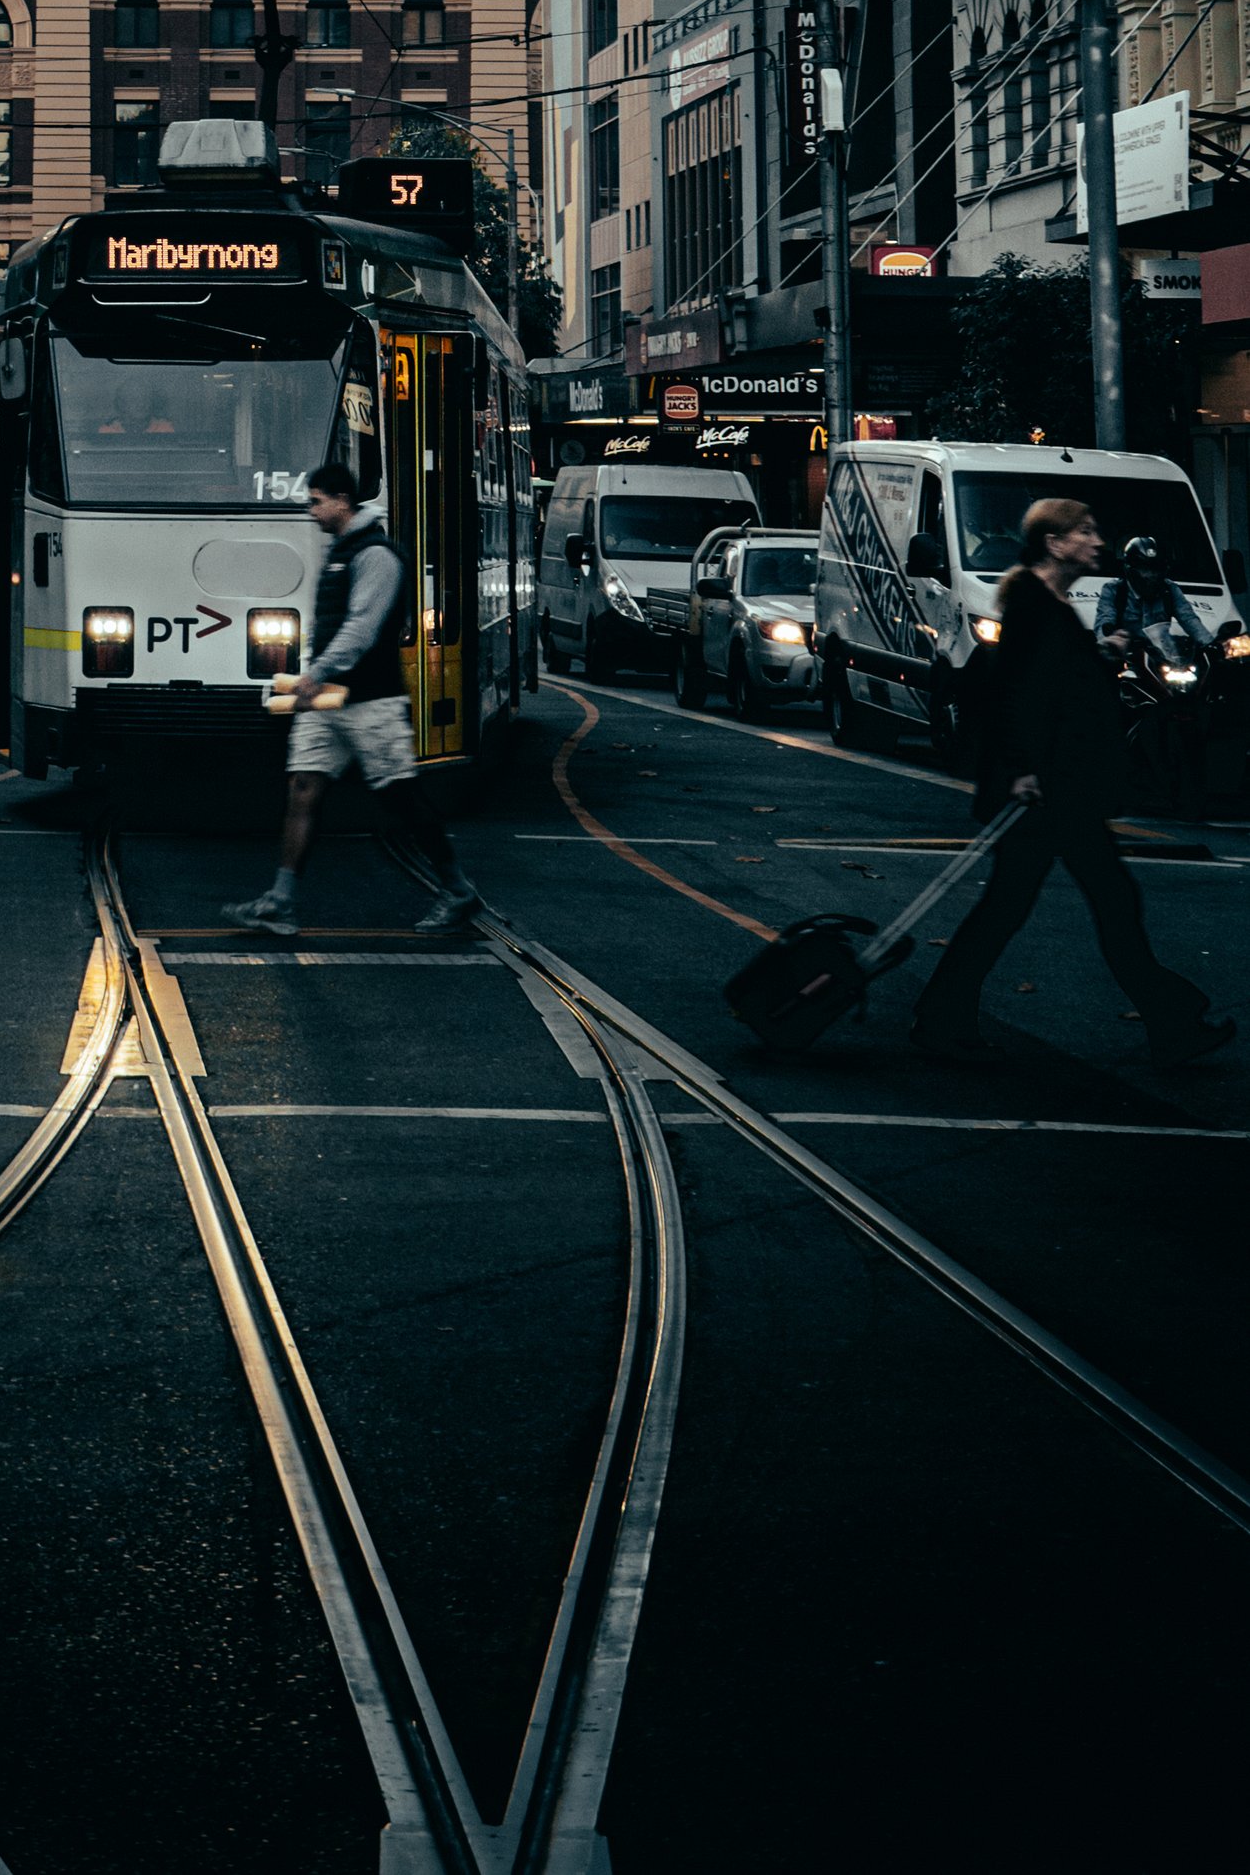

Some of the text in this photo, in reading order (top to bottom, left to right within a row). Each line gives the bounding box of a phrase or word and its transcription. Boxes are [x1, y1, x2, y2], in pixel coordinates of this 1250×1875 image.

[391, 175, 424, 205] 57
[108, 237, 279, 269] Maribyrnong
[253, 470, 310, 502] 154
